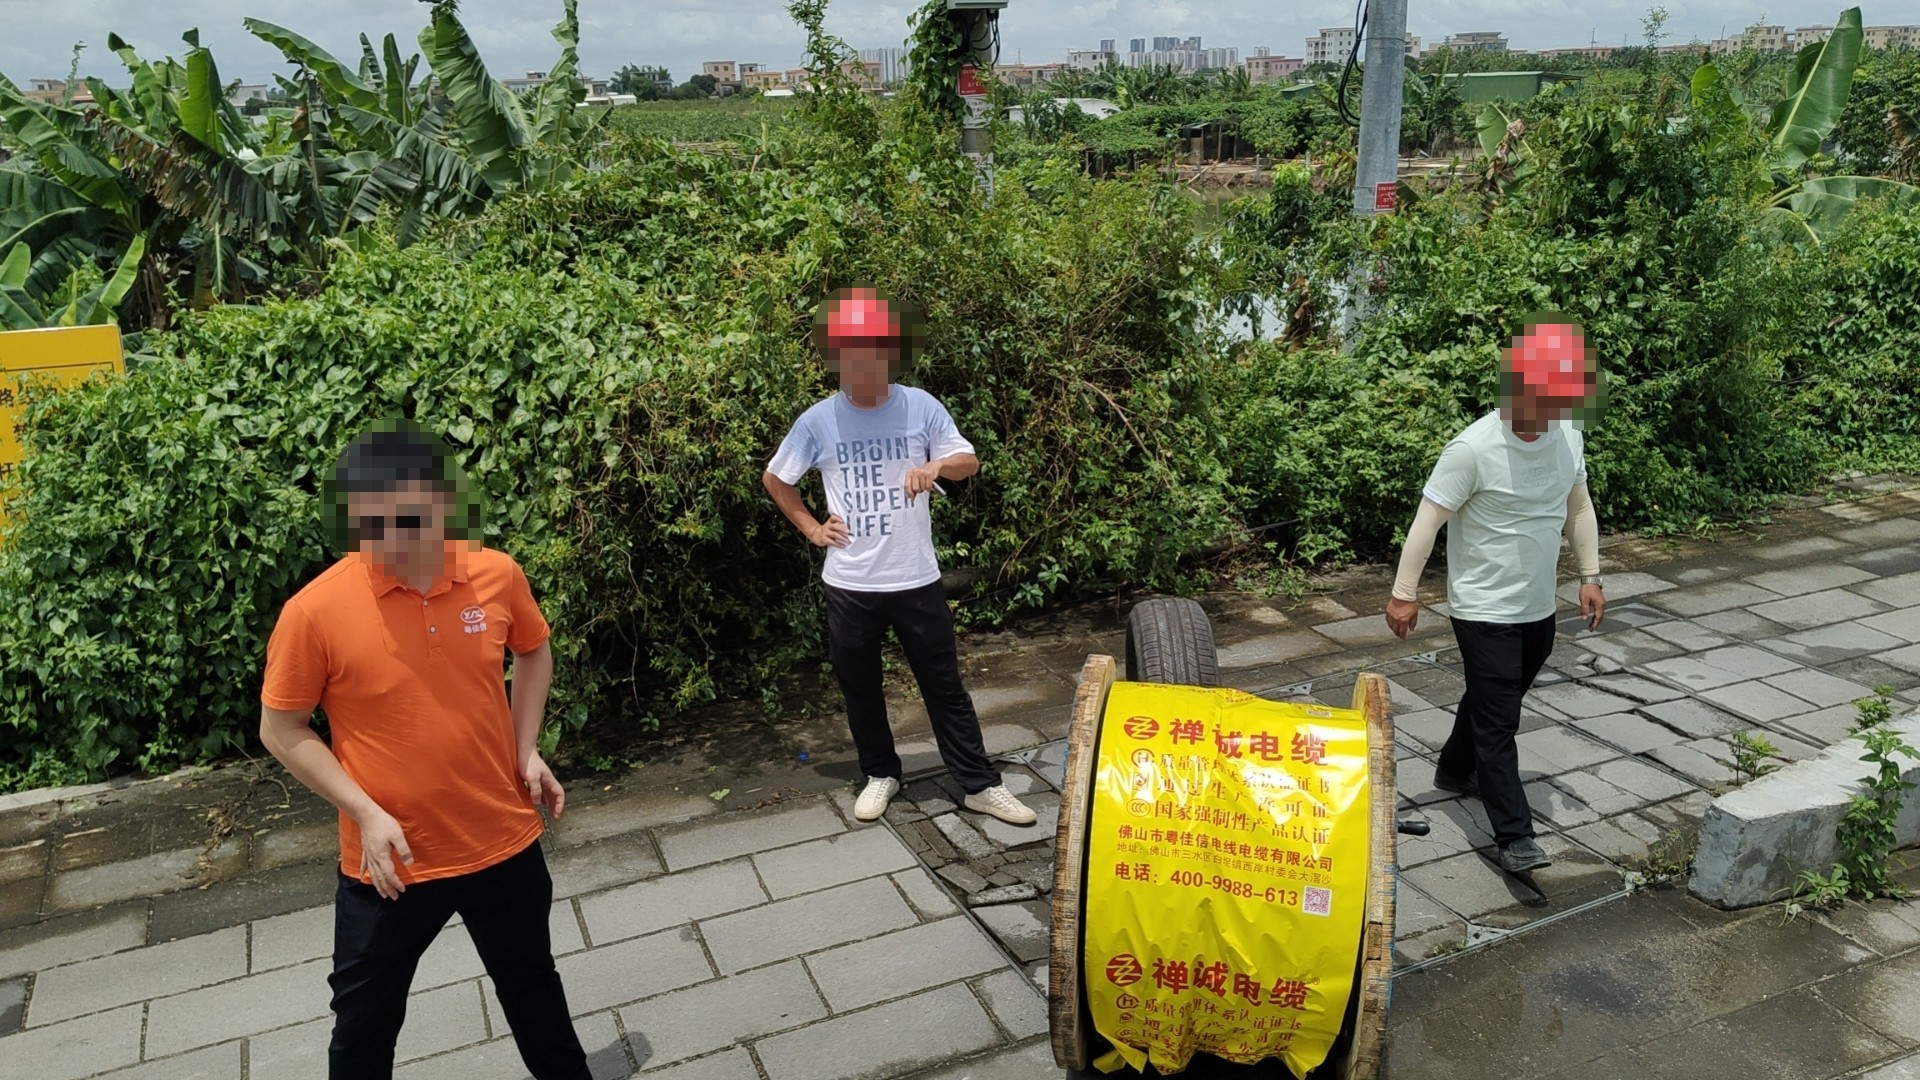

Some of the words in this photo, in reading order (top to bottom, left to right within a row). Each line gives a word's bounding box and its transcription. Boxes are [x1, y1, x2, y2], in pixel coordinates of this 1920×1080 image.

[836, 437, 909, 464] BRUIN
[840, 464, 884, 489] THE
[846, 514, 892, 537] LIFE
[1169, 718, 1328, 766] 禅诚电缆
[1154, 799, 1330, 845] 国家强制性产品认证
[1118, 824, 1333, 873] 佛山市粤佳信电线电缆有限公司
[1152, 957, 1309, 1011] 禅诚电缆
